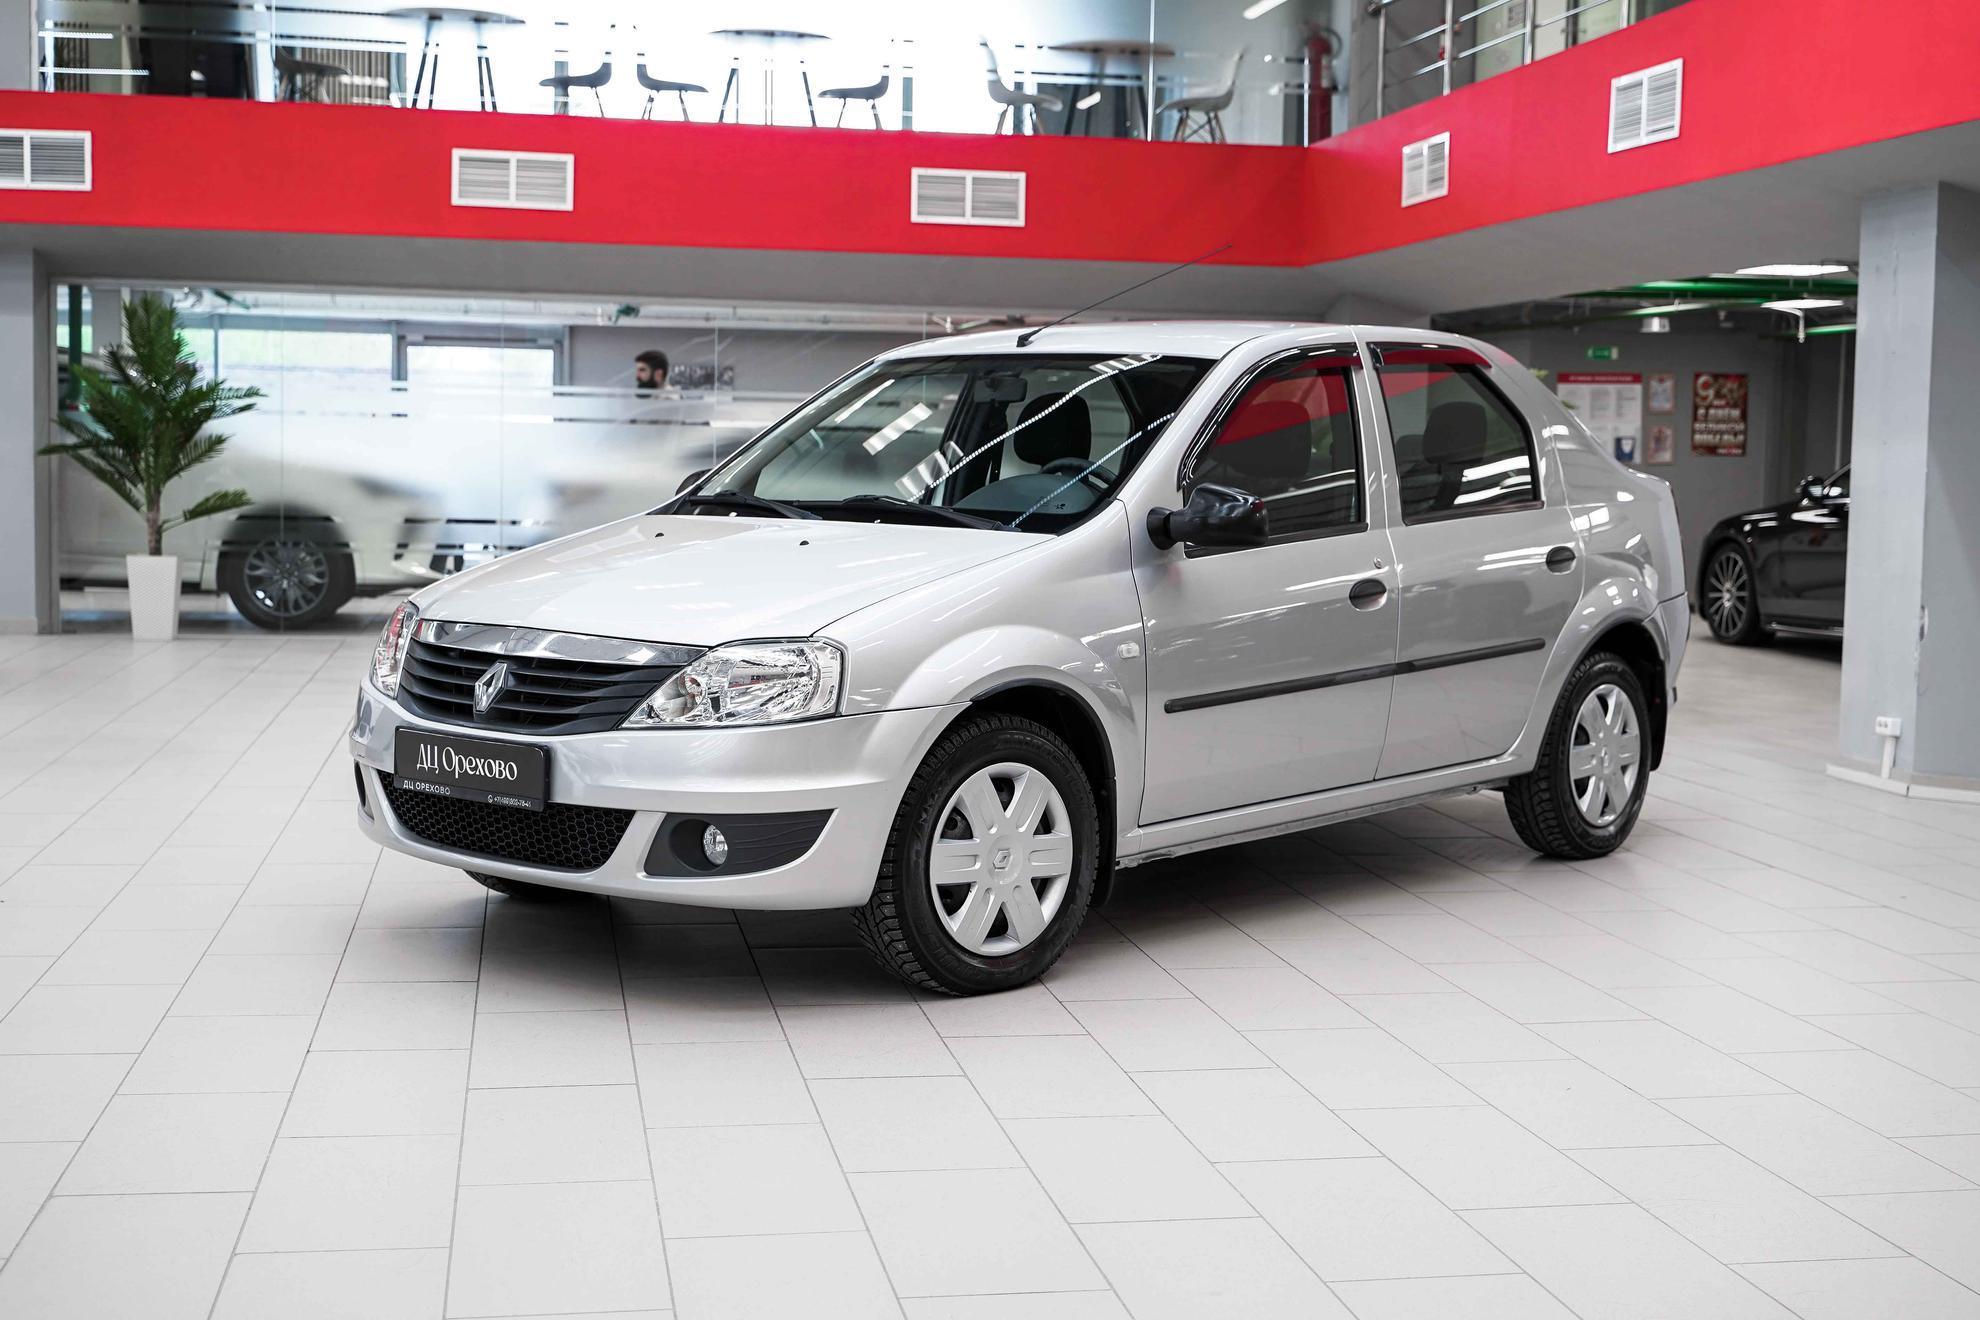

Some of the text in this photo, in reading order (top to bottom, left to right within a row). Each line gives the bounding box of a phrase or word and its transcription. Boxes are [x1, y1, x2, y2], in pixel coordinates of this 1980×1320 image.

[416, 743, 518, 780] ДЦ Орехово
[403, 780, 451, 795] ДЦ ОРЕХОВО
